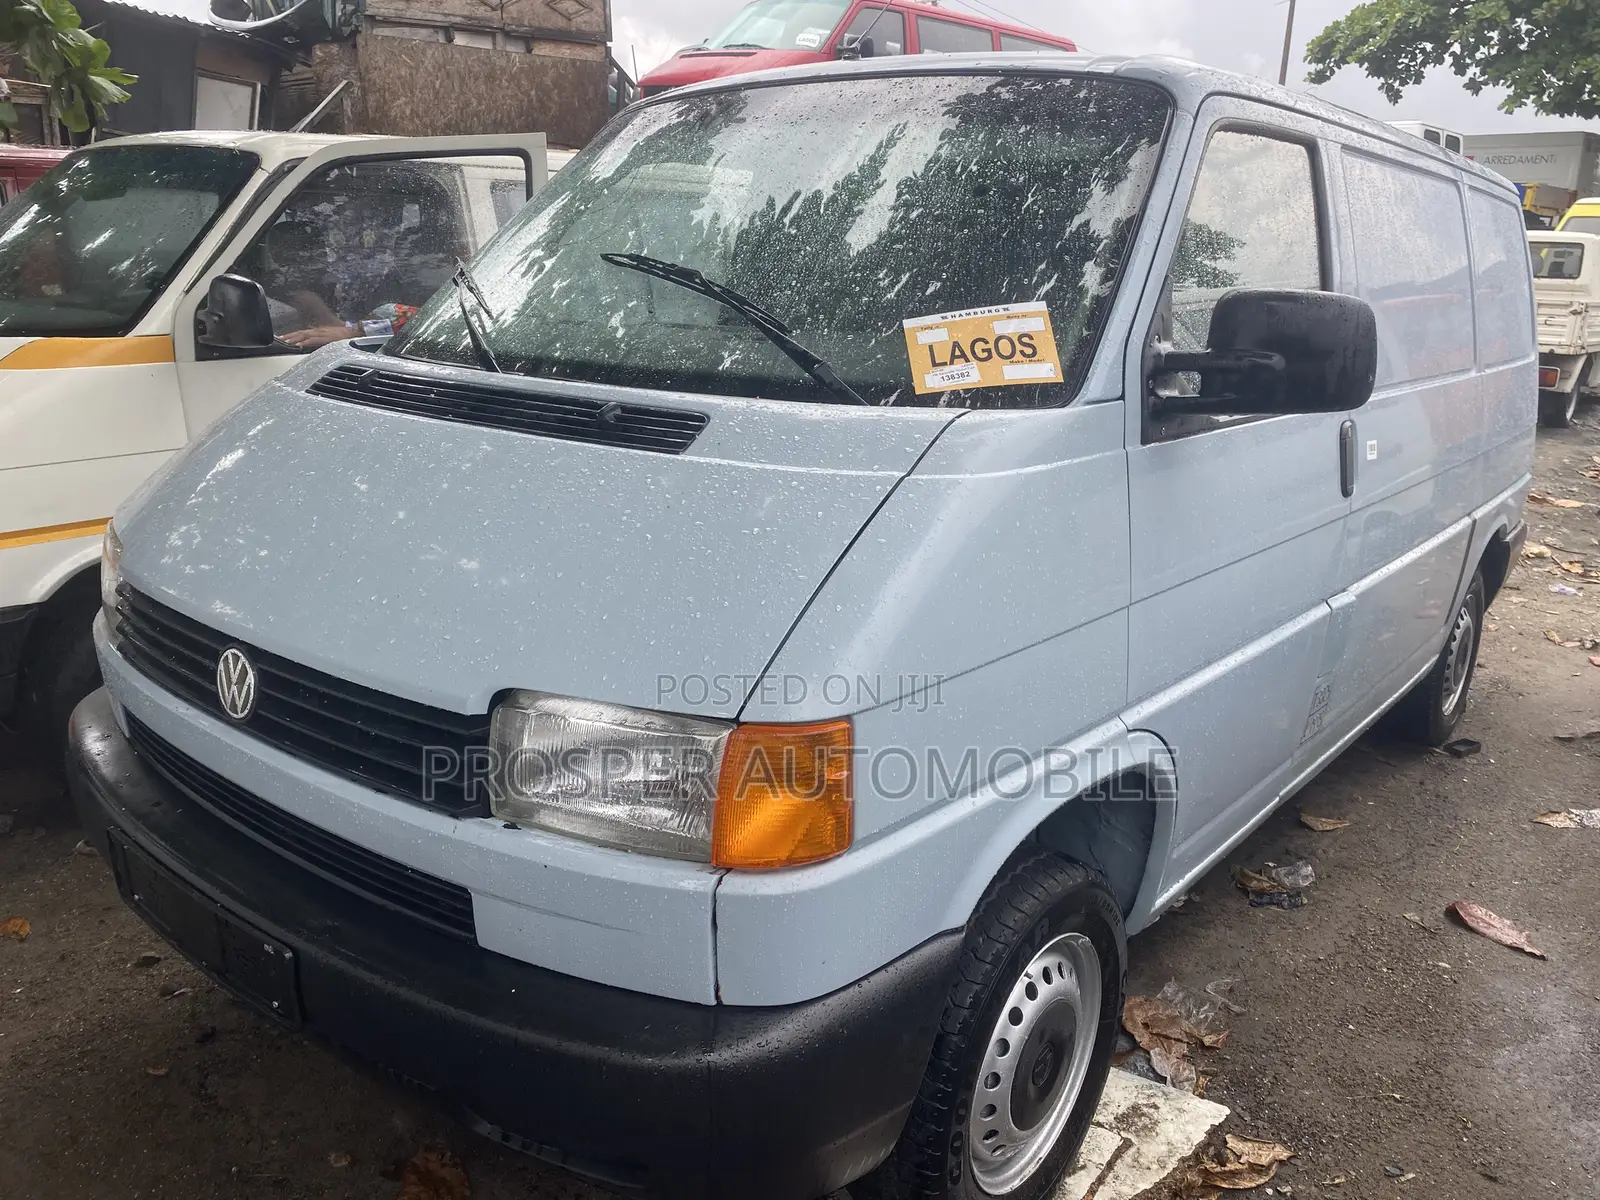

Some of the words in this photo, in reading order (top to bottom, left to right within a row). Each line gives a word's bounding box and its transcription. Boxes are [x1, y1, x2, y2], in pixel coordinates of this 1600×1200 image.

[951, 308, 1000, 319] HAMBURG
[928, 333, 1038, 368] LAGOS
[940, 371, 971, 382] 138382
[218, 648, 255, 719] VW
